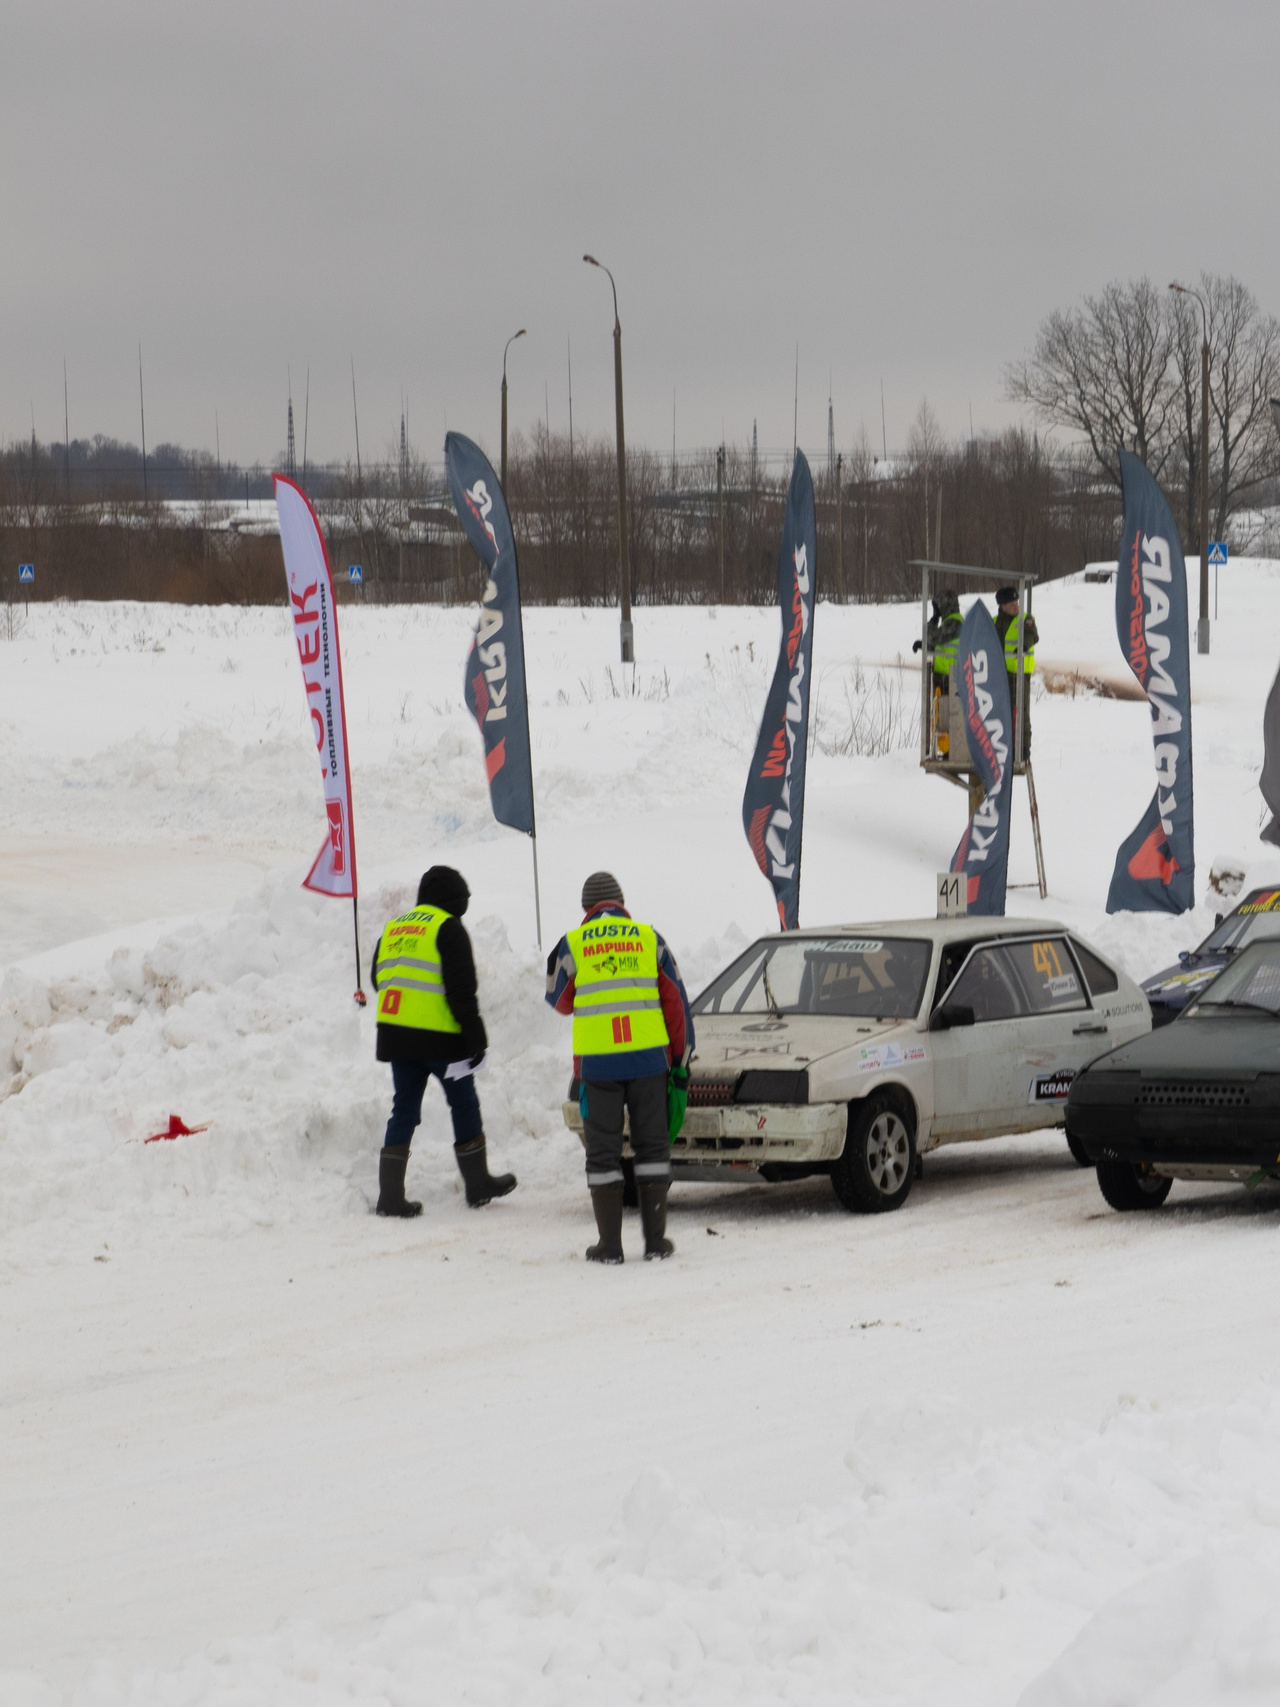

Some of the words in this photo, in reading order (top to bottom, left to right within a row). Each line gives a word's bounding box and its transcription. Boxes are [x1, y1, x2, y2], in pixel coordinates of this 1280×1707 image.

[320, 583, 330, 677] ТЕХНОЛОГИИ
[291, 577, 328, 780] TEK
[325, 687, 338, 777] ТОПЛИВНЫЕ
[939, 878, 960, 908] 41
[1237, 901, 1272, 916] FUTURE
[582, 925, 640, 942] RUSTA
[583, 941, 644, 958] МАРШАЛ
[1040, 1081, 1072, 1095] KRAM
